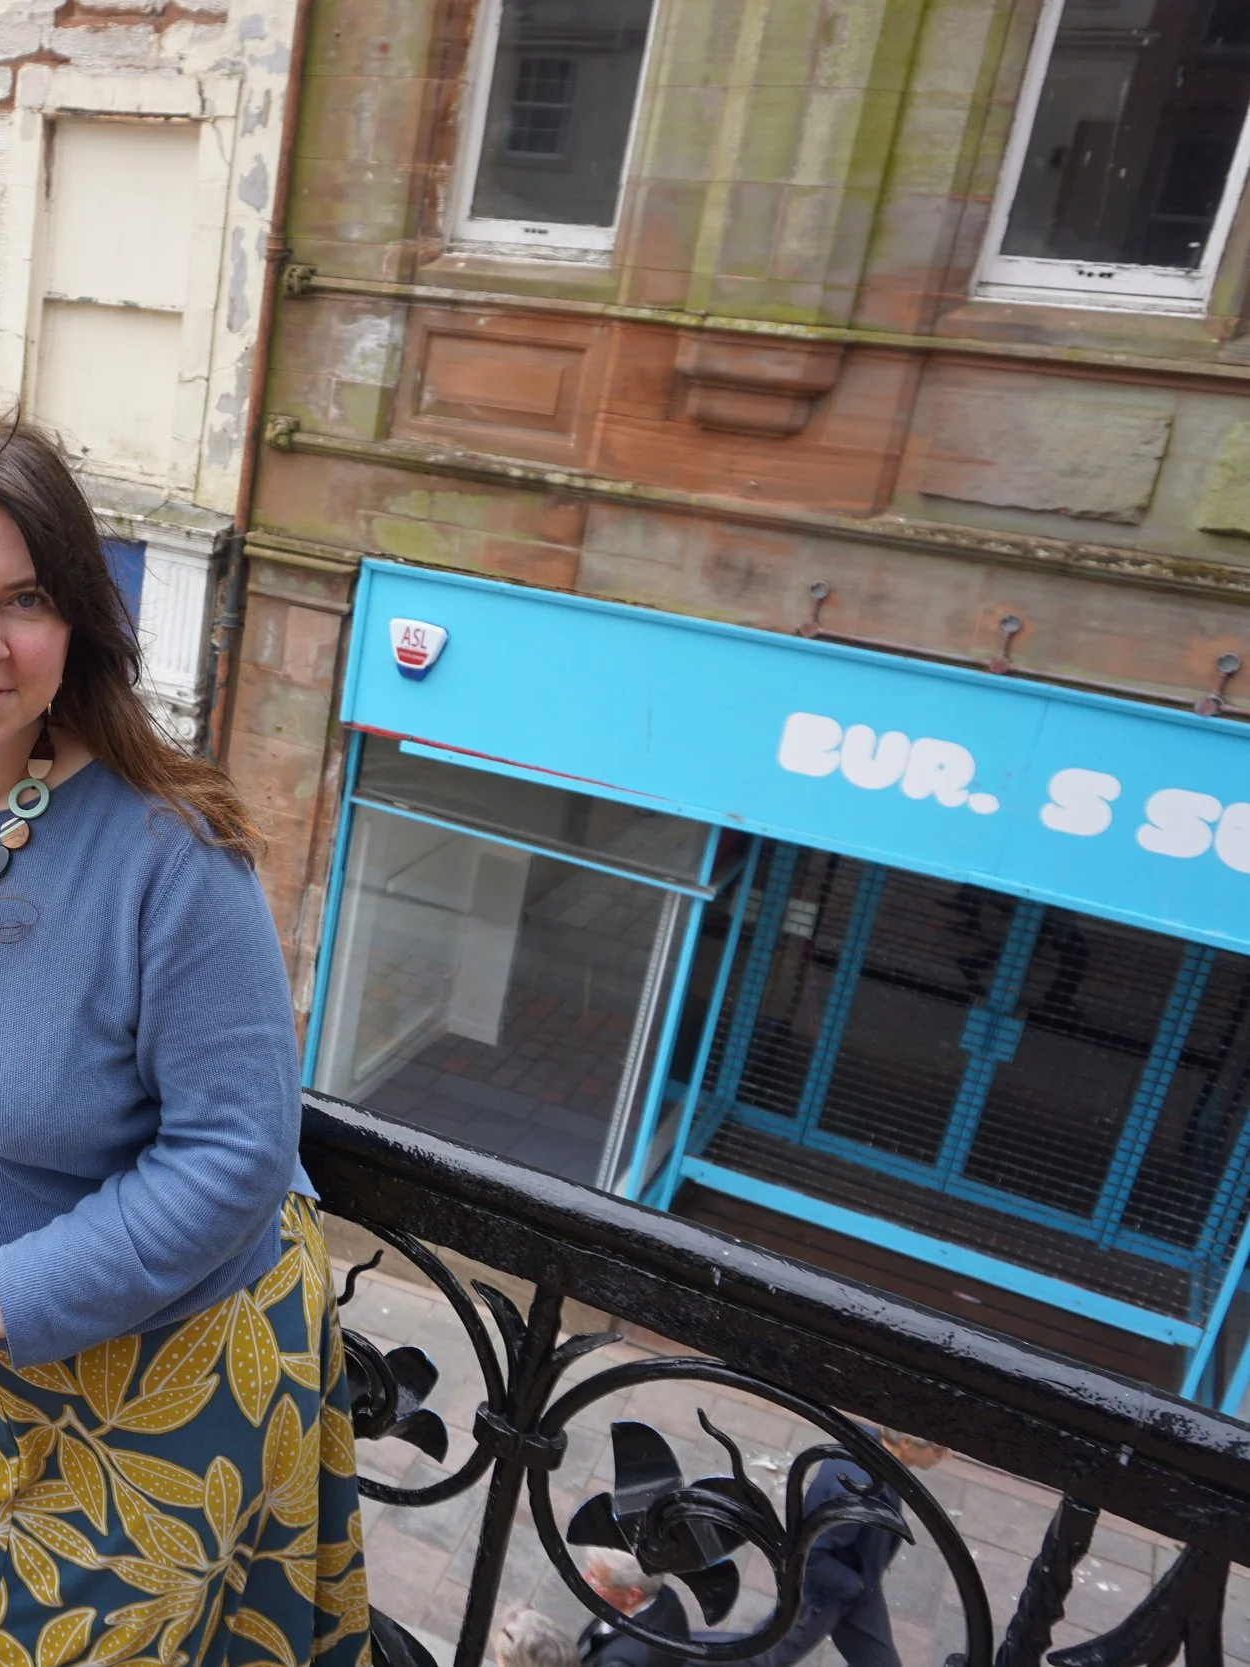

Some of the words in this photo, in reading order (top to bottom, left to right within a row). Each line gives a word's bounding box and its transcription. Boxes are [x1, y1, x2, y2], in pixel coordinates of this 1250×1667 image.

[401, 626, 427, 649] ASL
[777, 711, 1000, 815] BUR.
[1040, 767, 1121, 837] S
